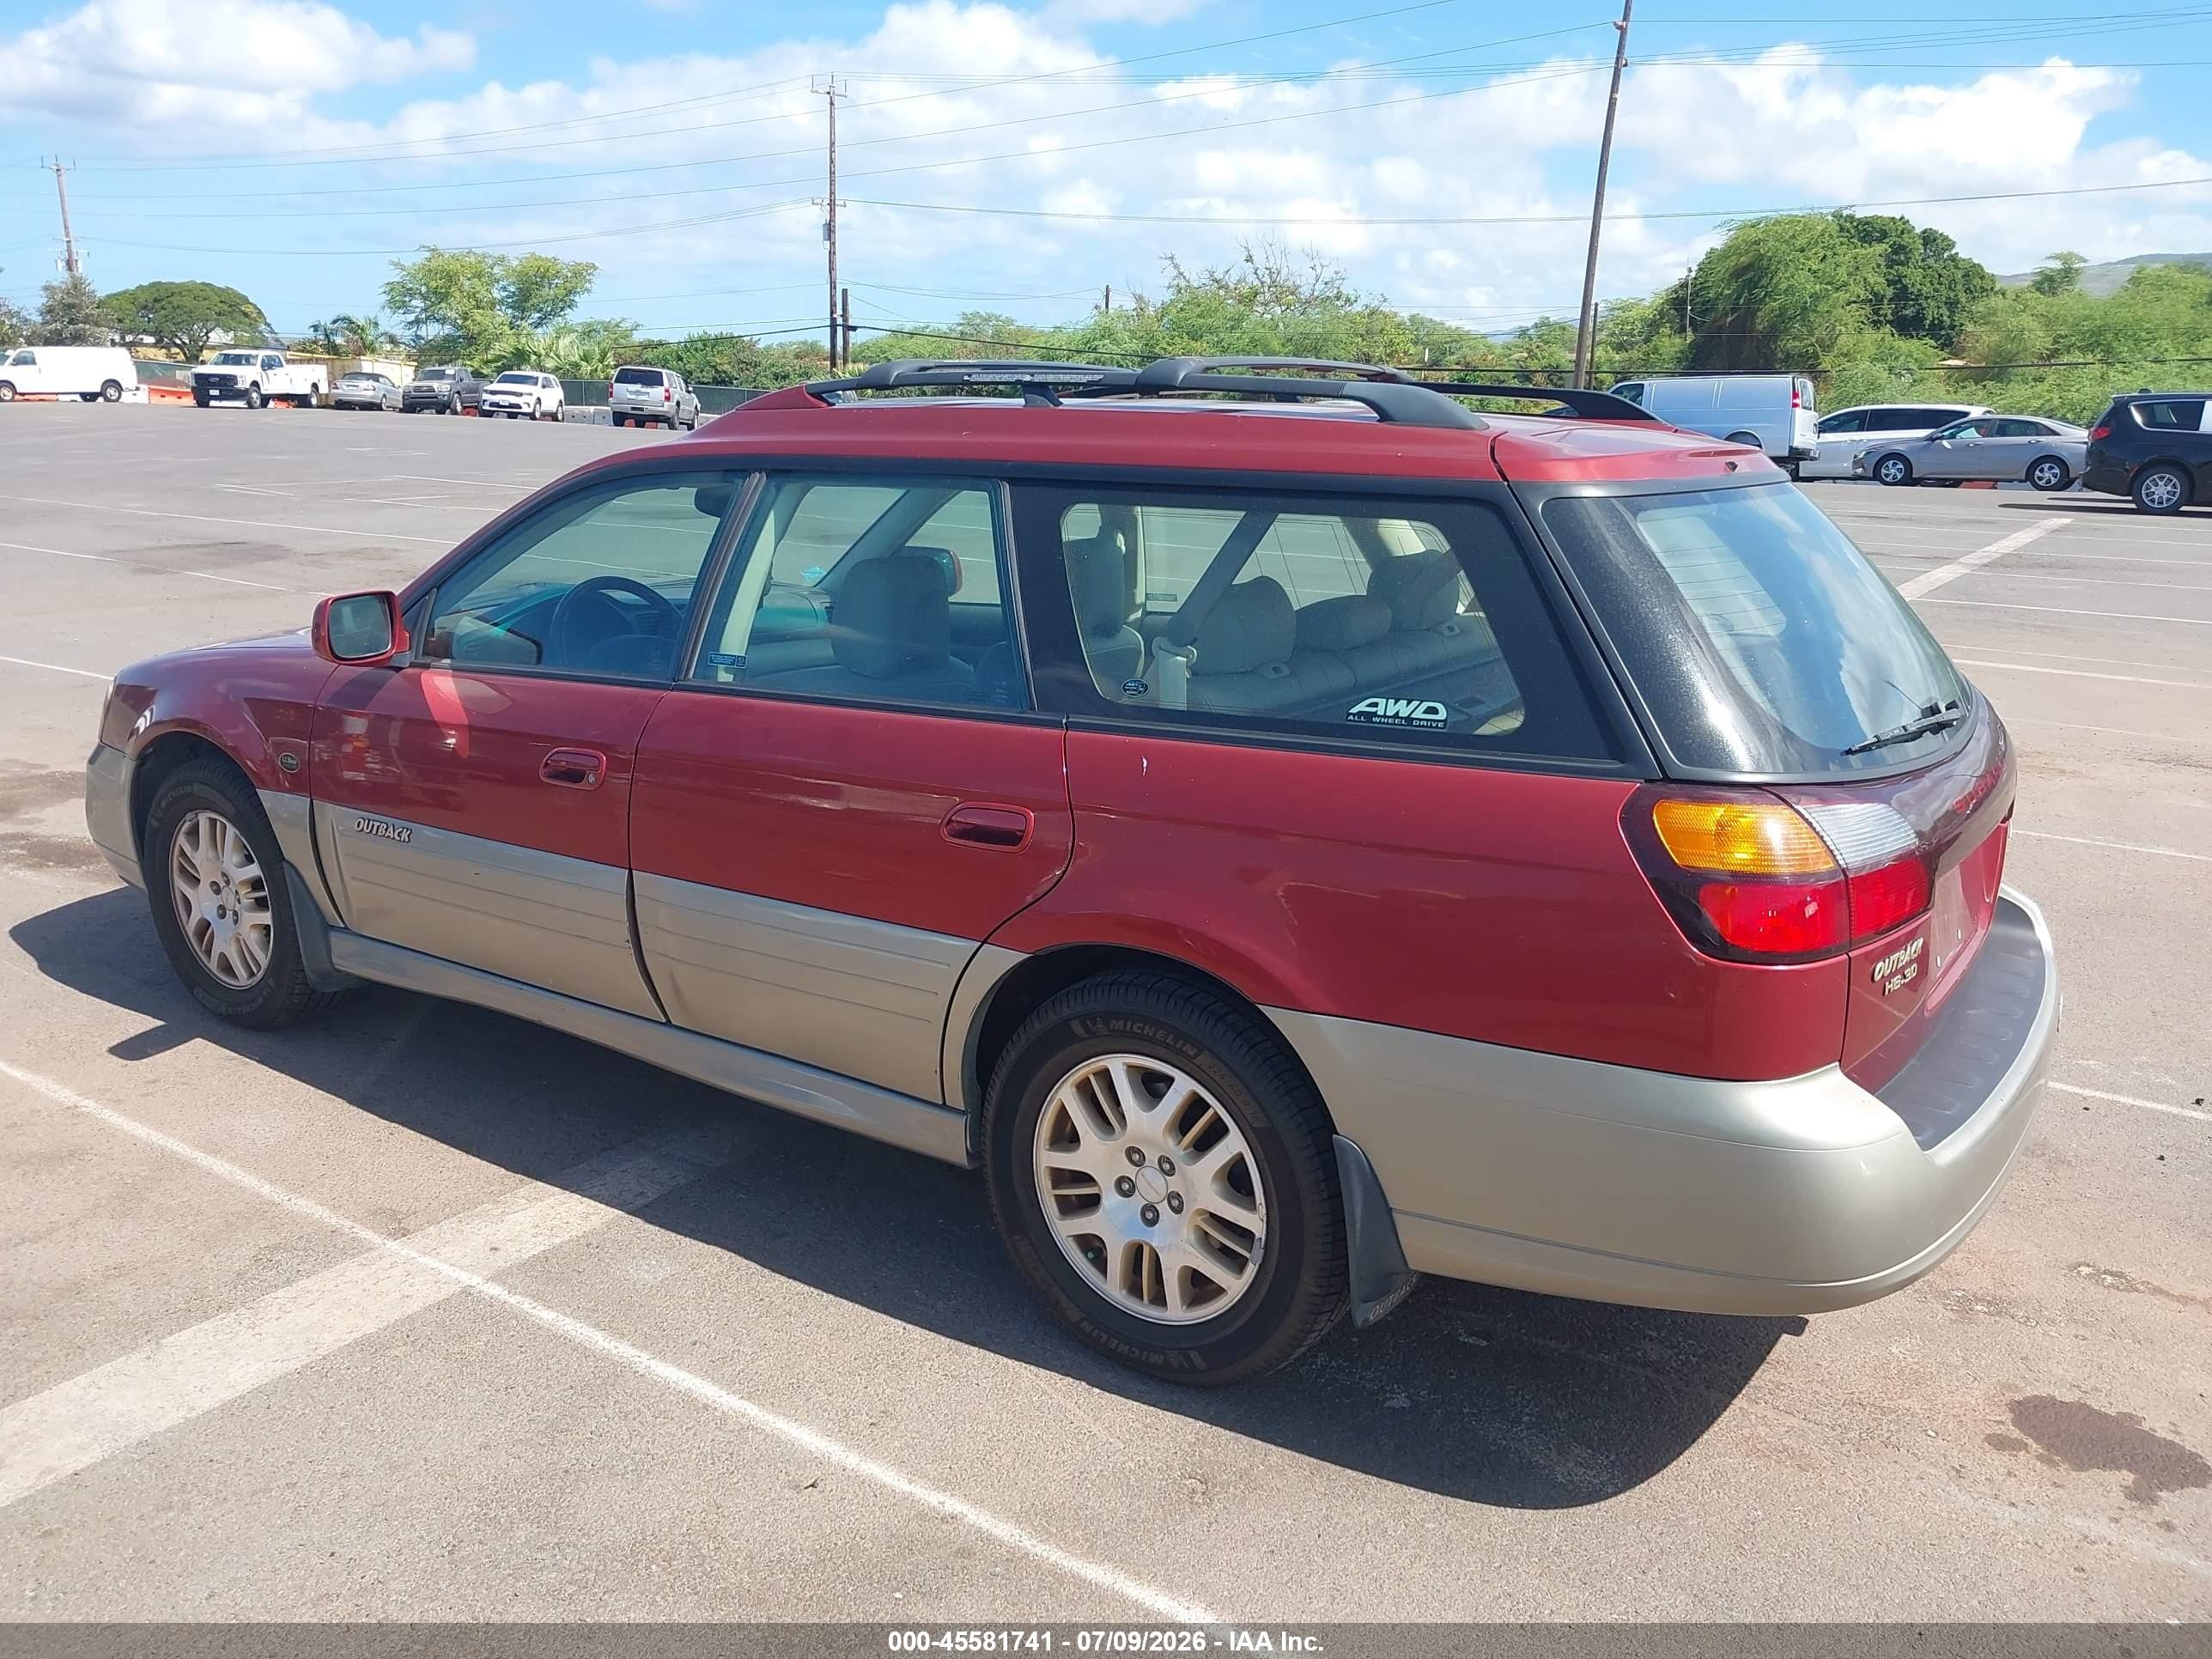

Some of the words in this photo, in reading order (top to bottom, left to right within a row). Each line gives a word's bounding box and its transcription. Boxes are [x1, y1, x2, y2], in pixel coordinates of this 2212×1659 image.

[1347, 696, 1448, 720] AWD
[1371, 716, 1408, 726] WHEEL
[1413, 719, 1445, 728] DRIVE
[356, 817, 412, 842] OUTBACK
[1872, 937, 1923, 982] OUTBACK
[1110, 1018, 1198, 1057] MICHELIN
